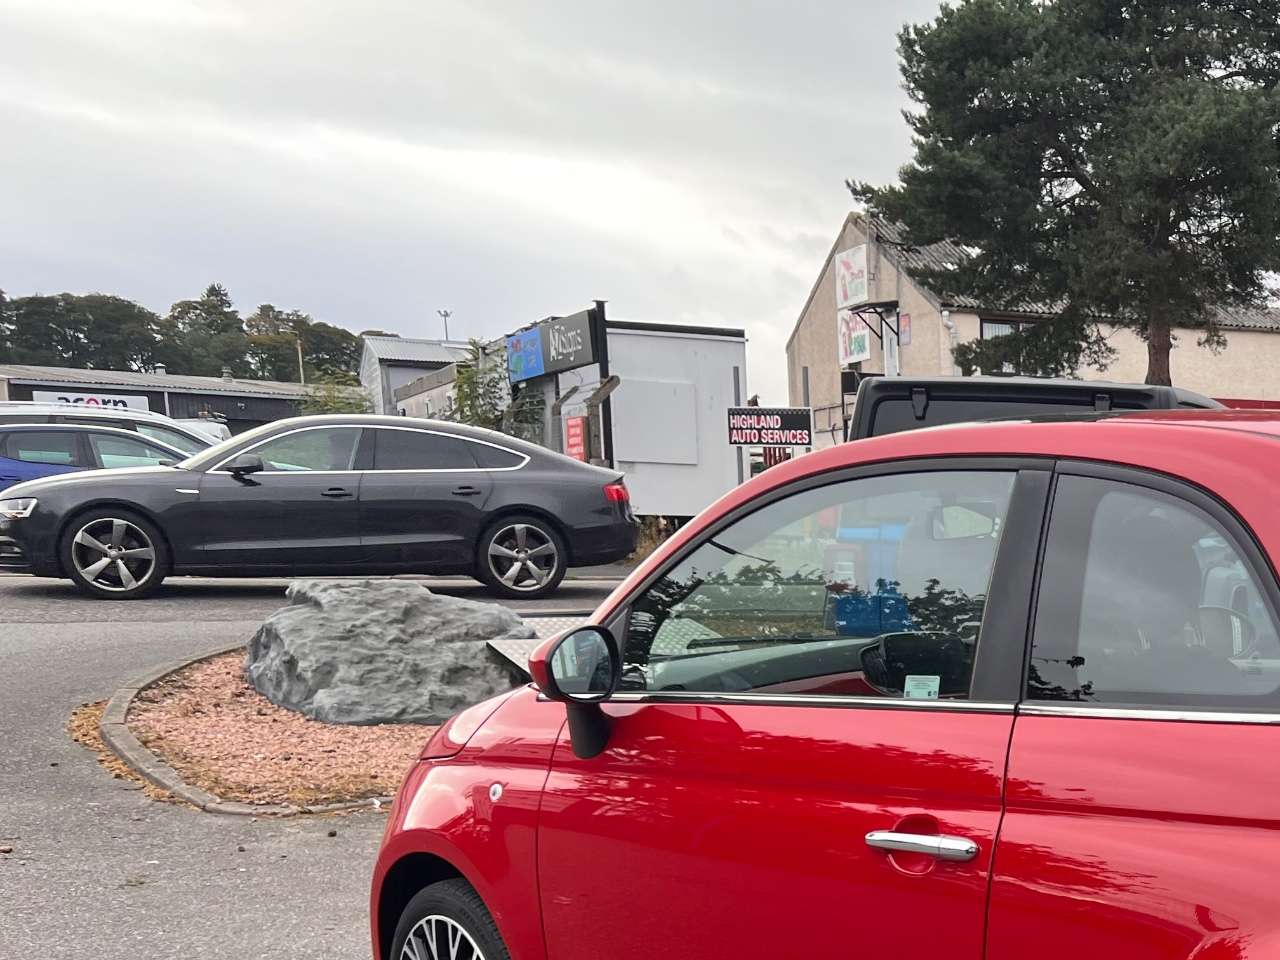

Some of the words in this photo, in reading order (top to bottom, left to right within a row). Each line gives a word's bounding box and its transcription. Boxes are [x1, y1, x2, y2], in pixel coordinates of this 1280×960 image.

[729, 415, 782, 429] HIGHLAND
[731, 429, 759, 443] AUTO
[760, 429, 809, 444] SERVICES
